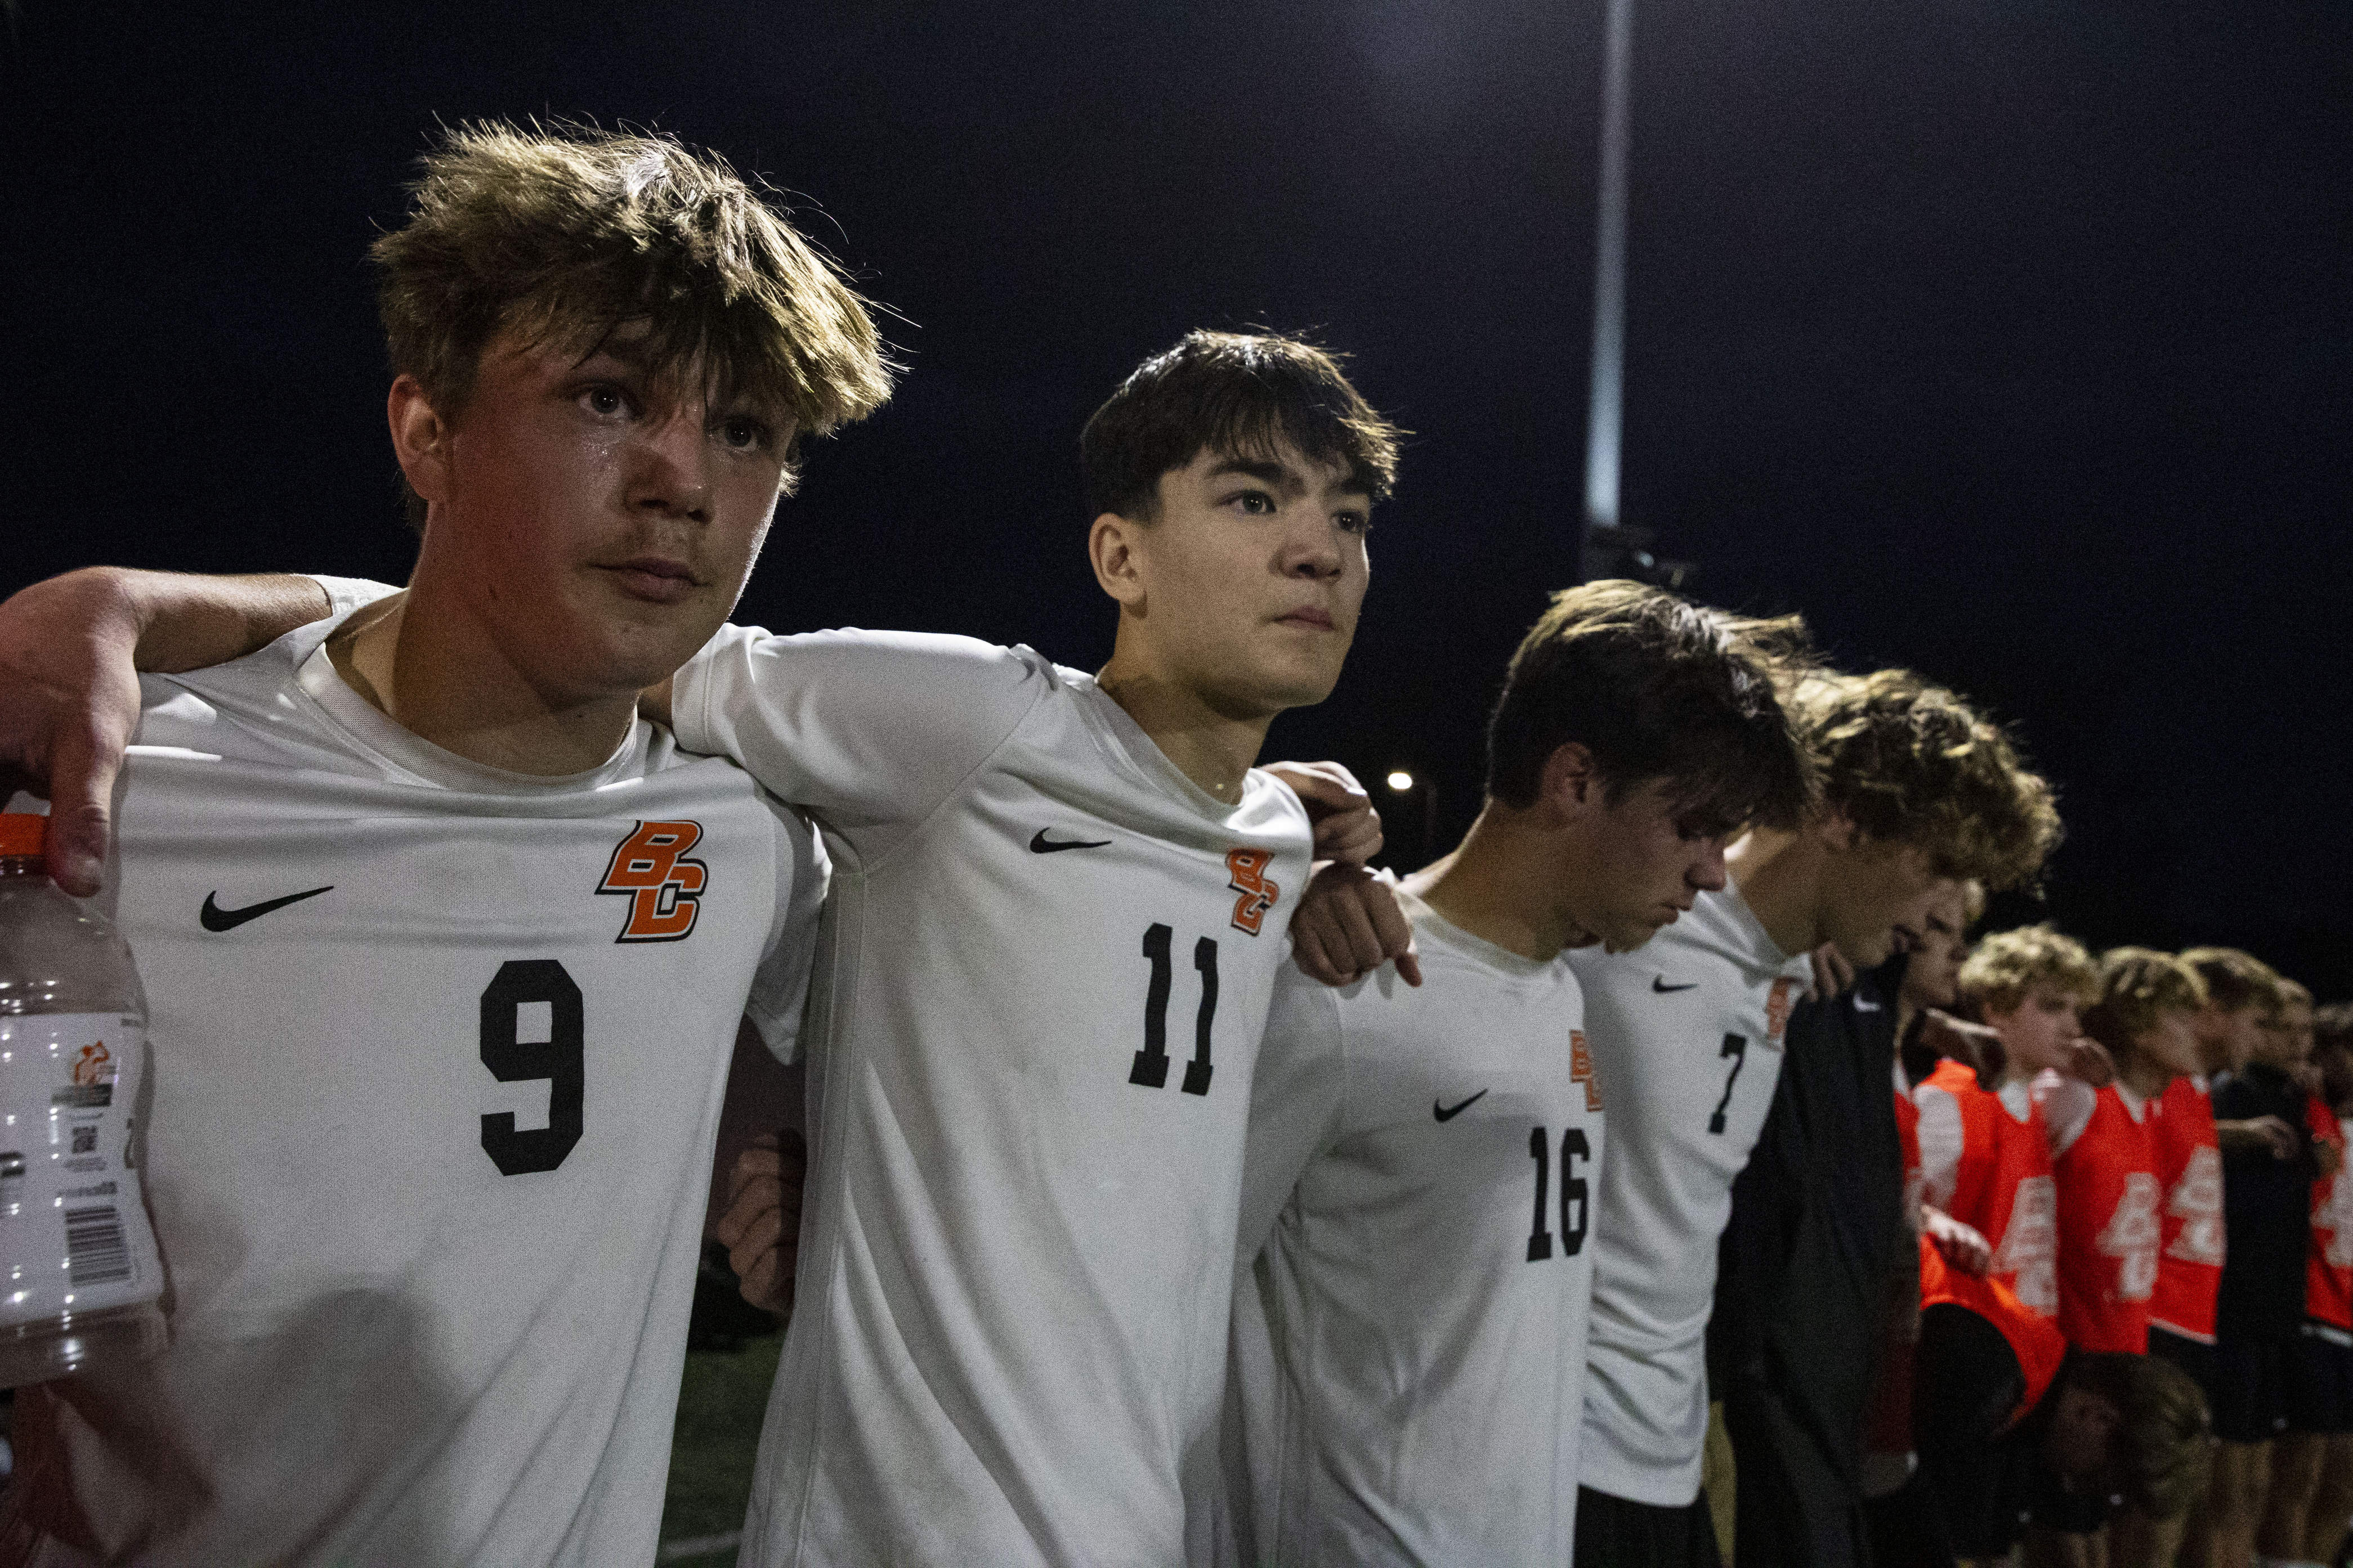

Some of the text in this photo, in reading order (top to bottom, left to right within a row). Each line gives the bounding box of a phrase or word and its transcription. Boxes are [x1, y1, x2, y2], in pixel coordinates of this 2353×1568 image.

[594, 819, 708, 943] BC
[1224, 848, 1280, 937] BC
[480, 959, 584, 1176] 9
[1129, 922, 1219, 1096] 11
[1708, 1032, 1746, 1135] 7
[1526, 1126, 1590, 1263] 16
